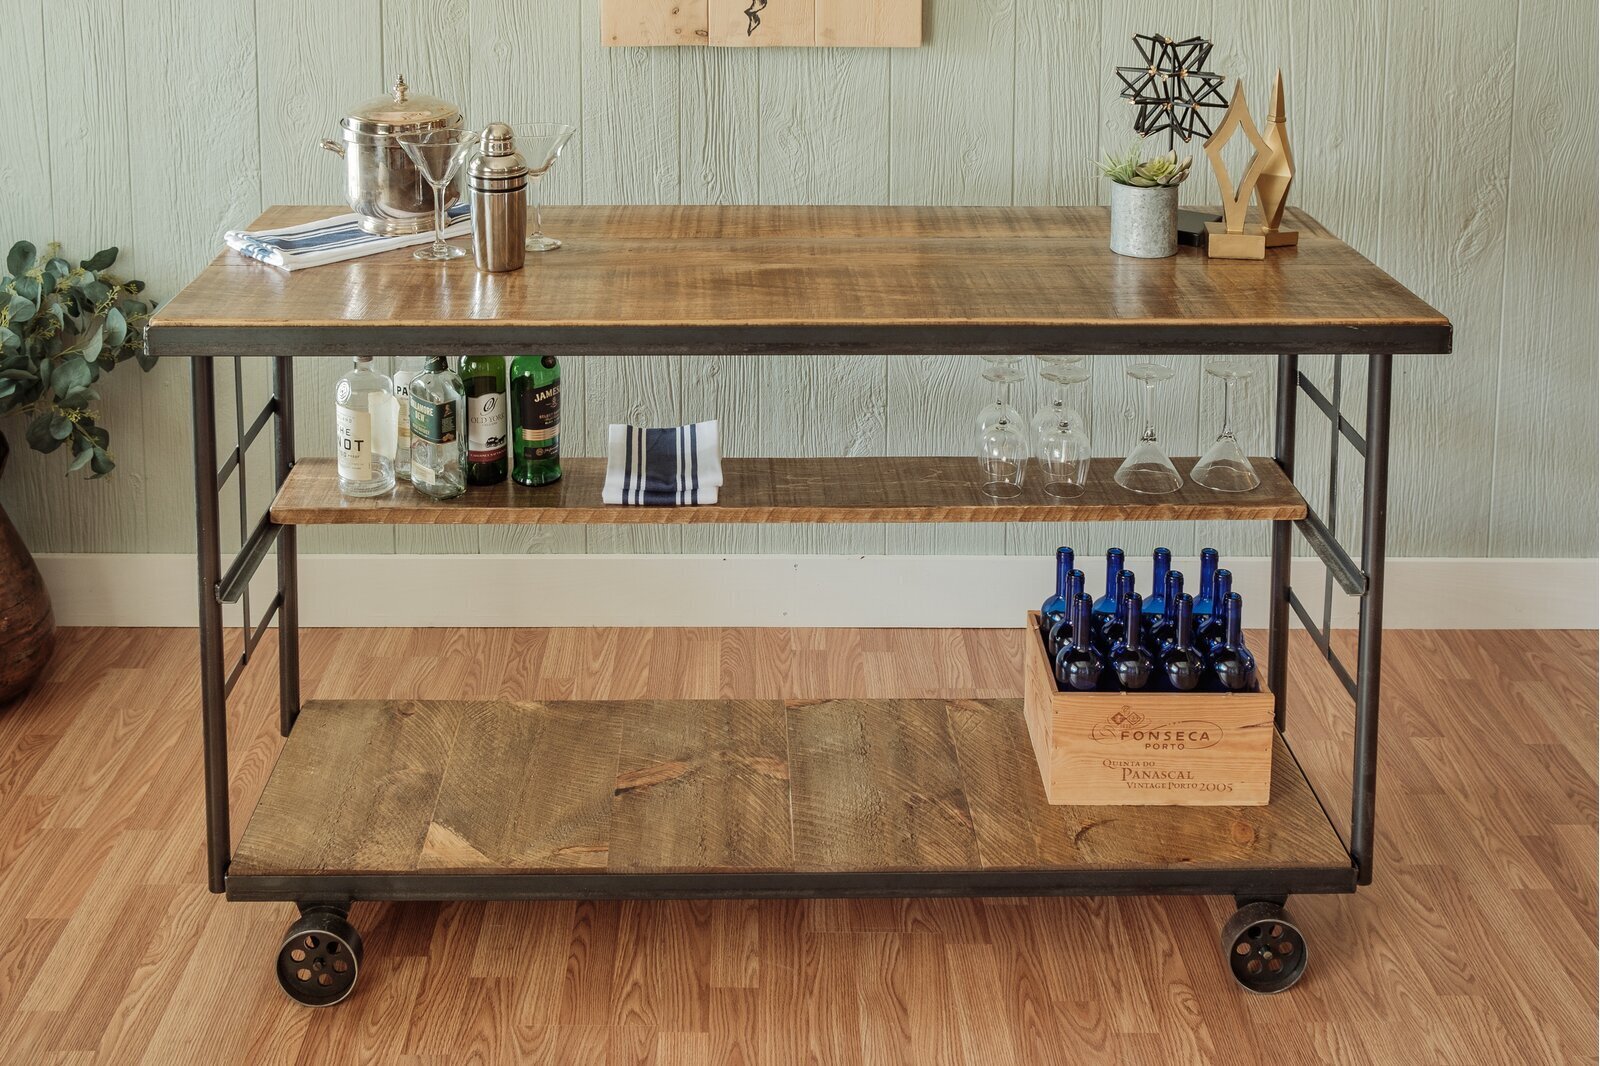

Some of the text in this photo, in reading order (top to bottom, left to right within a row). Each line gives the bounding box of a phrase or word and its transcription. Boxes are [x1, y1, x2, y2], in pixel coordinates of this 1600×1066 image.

[470, 416, 488, 424] OLD
[1121, 730, 1211, 741] FONSECA
[1145, 743, 1185, 751] PORTO
[1102, 758, 1141, 770] QUINTA
[1121, 767, 1195, 782] PANASCAL
[1127, 781, 1233, 793] VINTAGE PORTO 2005
